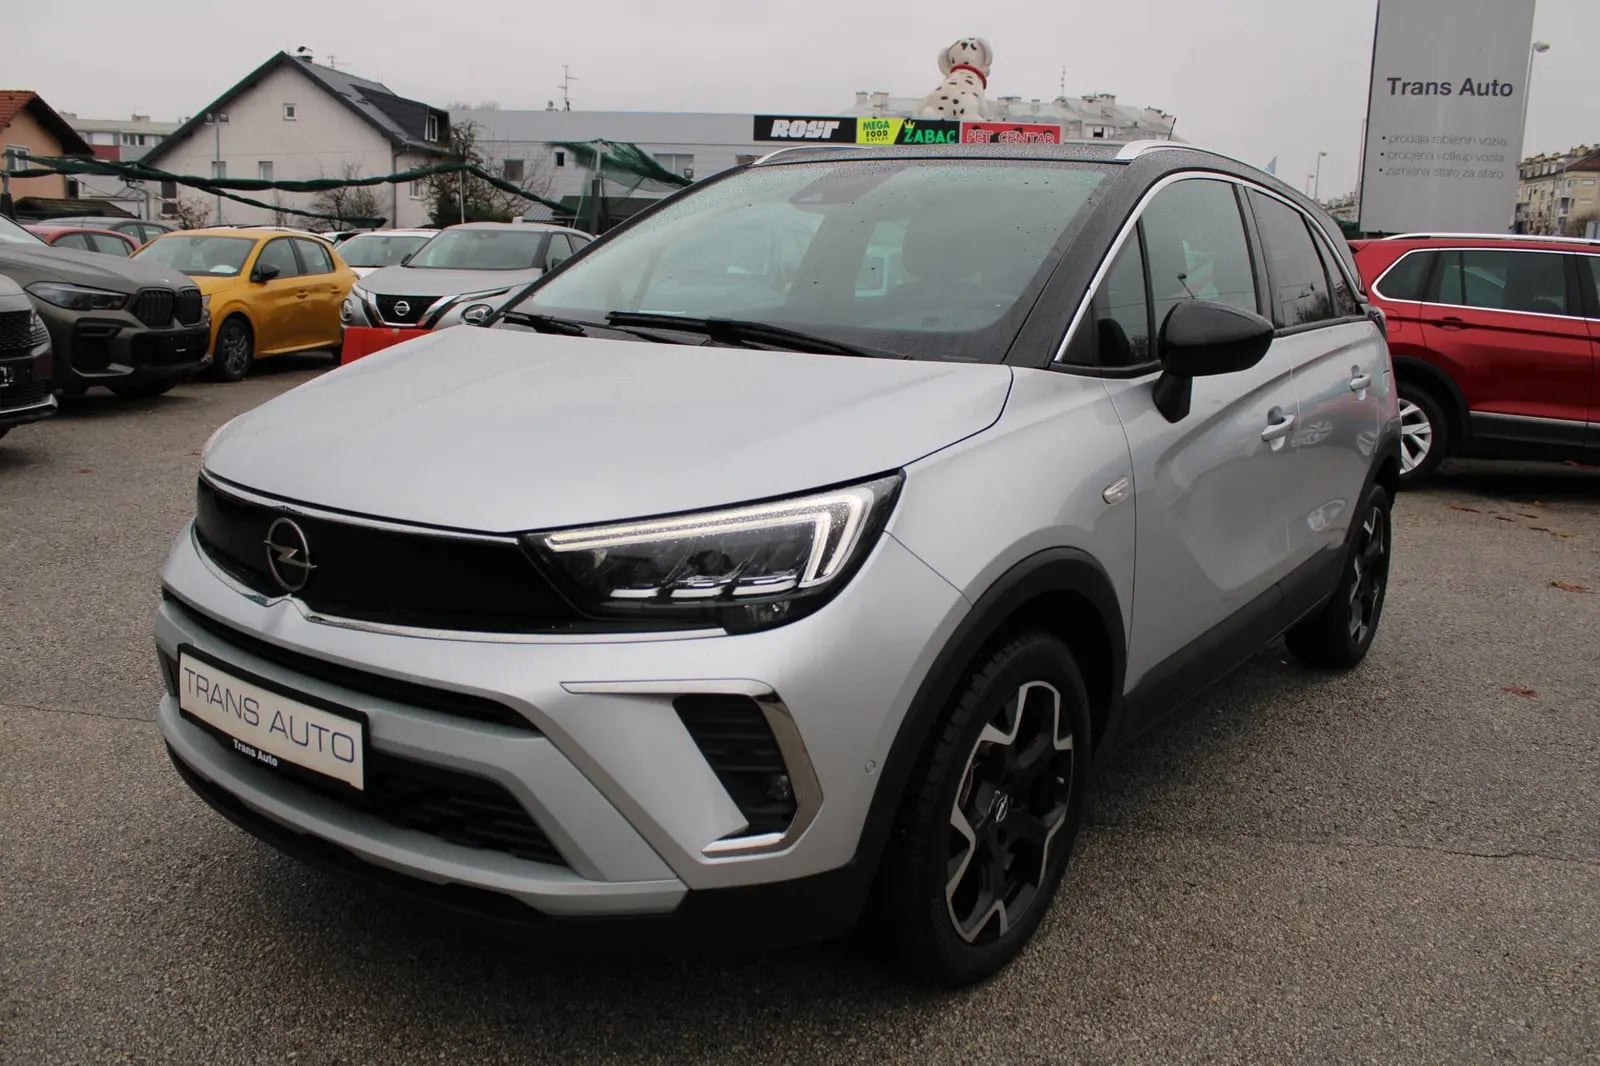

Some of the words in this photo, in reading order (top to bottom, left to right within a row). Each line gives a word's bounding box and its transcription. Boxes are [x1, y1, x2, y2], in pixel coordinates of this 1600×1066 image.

[1387, 77, 1452, 96] Trans
[1458, 78, 1513, 97] Auto
[770, 119, 840, 139] ROST
[863, 120, 890, 130] MEGA
[967, 128, 993, 144] PET
[998, 130, 1055, 145] CENTAR
[1388, 133, 1429, 145] prodaja
[1387, 151, 1434, 163] procjena
[1442, 151, 1473, 163] otkup
[1462, 169, 1475, 178] za
[184, 667, 260, 727] TRANS
[269, 710, 354, 763] AUTO
[233, 738, 257, 758] Trans
[257, 750, 278, 767] Auto
